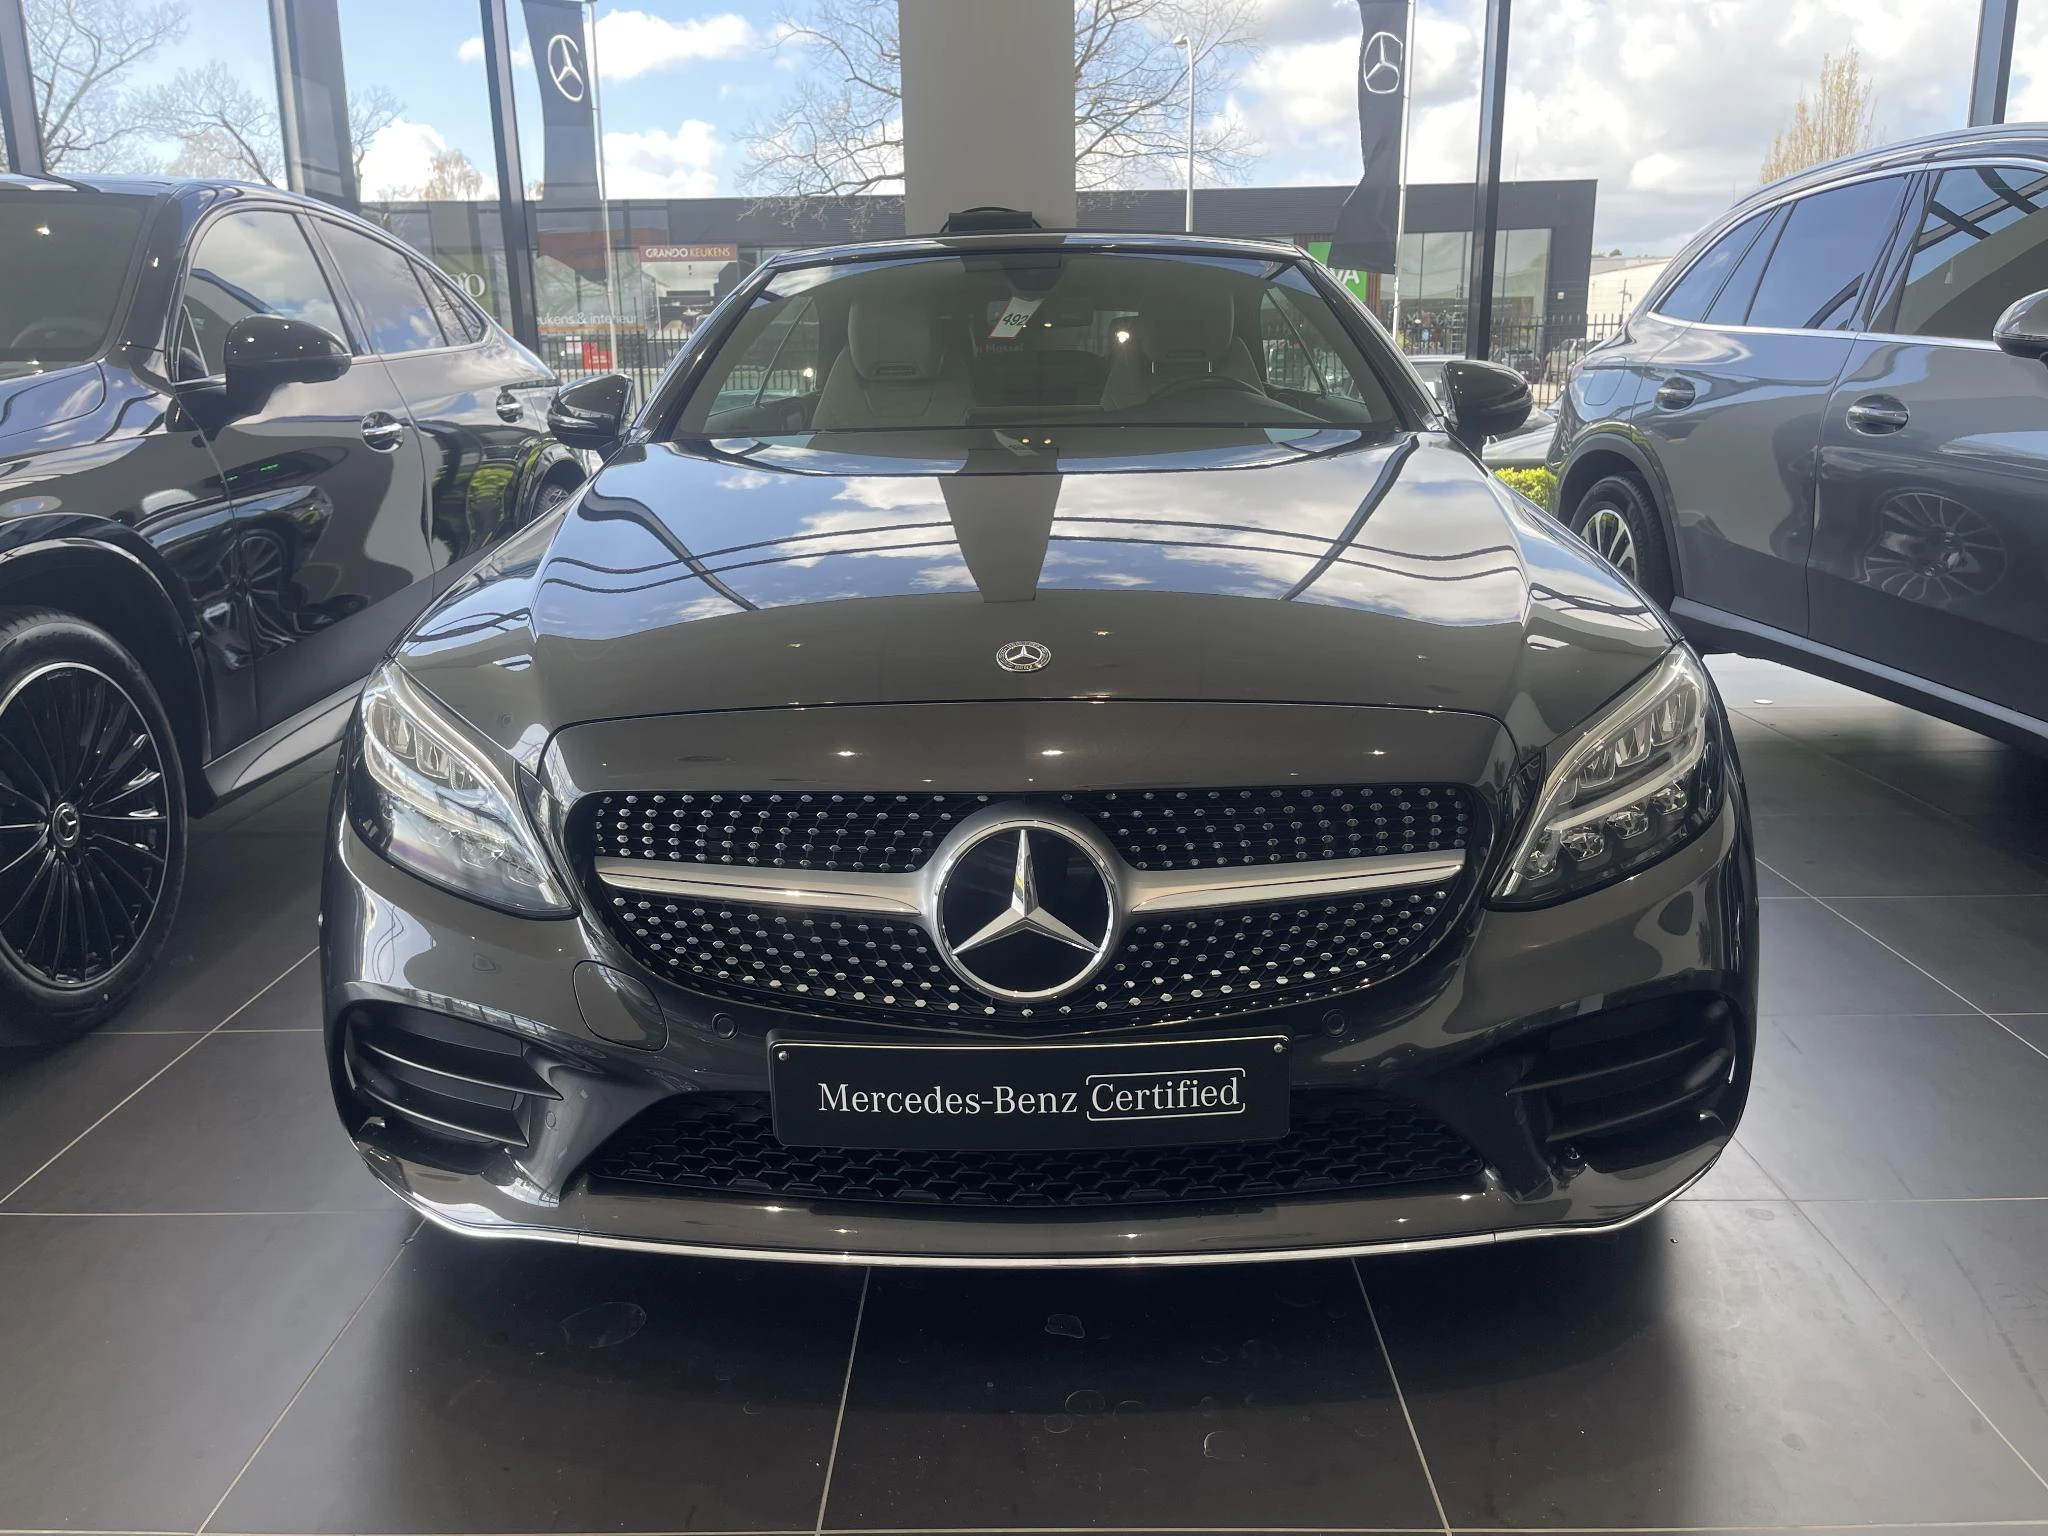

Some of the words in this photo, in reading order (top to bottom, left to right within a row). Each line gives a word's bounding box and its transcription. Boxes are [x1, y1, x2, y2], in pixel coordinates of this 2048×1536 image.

[645, 248, 688, 258] GRANDO
[690, 247, 730, 257] KEUKENS
[537, 313, 575, 325] ukens
[577, 312, 587, 324] &
[1003, 313, 1029, 326] 492
[818, 1083, 1078, 1114] Mercedes-Benz
[1091, 1078, 1238, 1112] Certified
